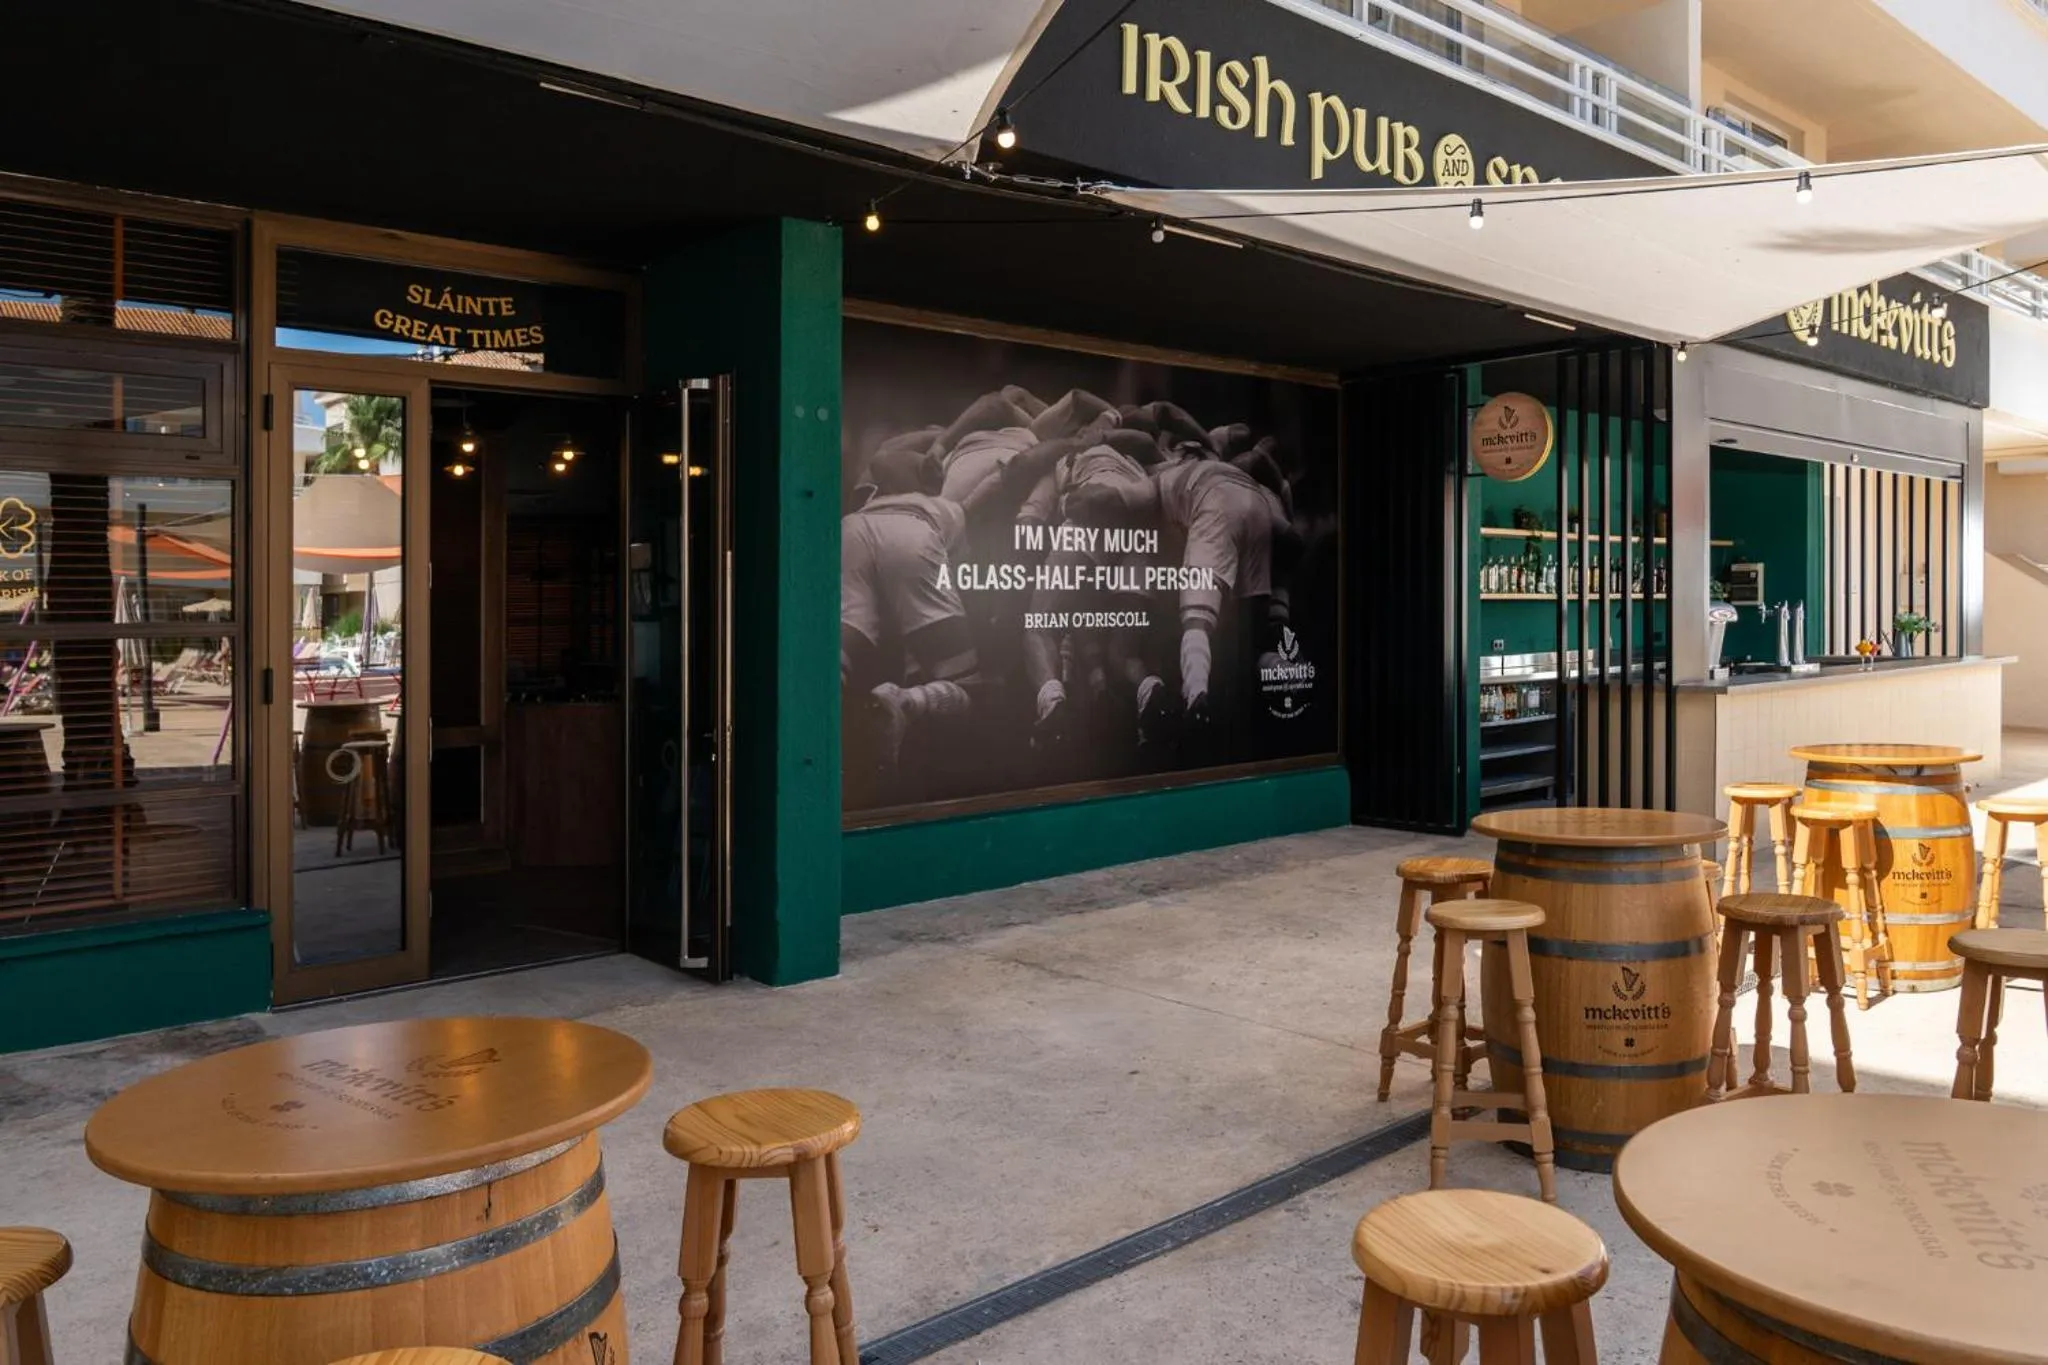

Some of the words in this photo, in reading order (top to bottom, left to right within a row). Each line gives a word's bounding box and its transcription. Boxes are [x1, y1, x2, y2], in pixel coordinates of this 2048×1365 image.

[1442, 158, 1469, 177] AND
[406, 284, 516, 317] SLÁINTE
[374, 308, 462, 346] GREAT
[467, 325, 545, 349] TIMES
[1014, 524, 1043, 550] I'M
[1049, 526, 1100, 552] VERY
[1104, 529, 1158, 553] MUCH
[12, 568, 33, 581] OF
[935, 563, 952, 590] A
[957, 563, 1140, 590] GLASS-HALF-FULL
[1145, 568, 1218, 590] PERSON.
[1024, 613, 1069, 629] BRIAN
[1072, 611, 1150, 628] O'DRISCOLL
